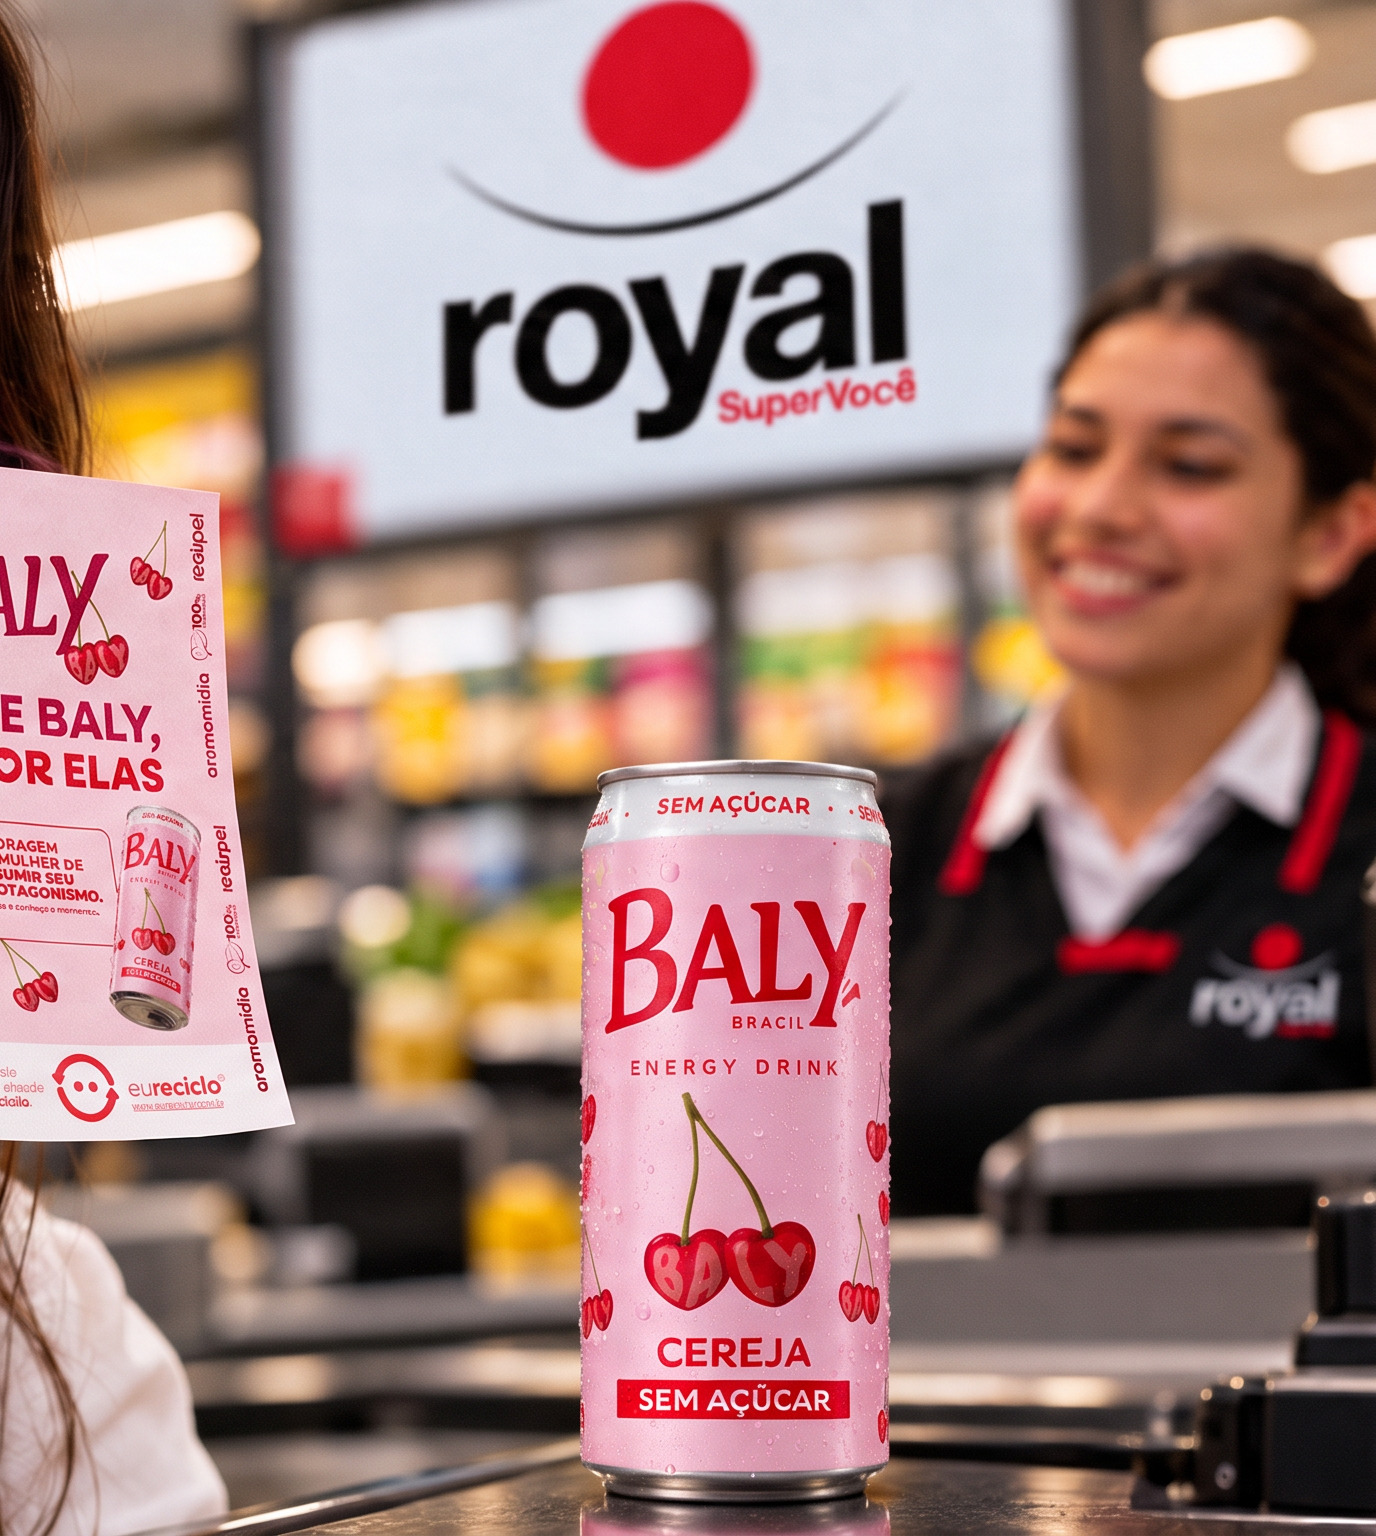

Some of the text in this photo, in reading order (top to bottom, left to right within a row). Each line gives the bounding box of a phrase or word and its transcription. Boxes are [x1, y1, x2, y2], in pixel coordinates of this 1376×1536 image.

[442, 198, 908, 441] royal
[37, 697, 162, 754] BALY,
[63, 747, 165, 793] ELAS
[656, 791, 810, 818] SEM AÇÚCAR
[63, 858, 84, 872] DE
[124, 832, 197, 885] BALY
[45, 872, 75, 886] SEU
[604, 887, 867, 1034] BALY
[731, 1015, 804, 1030] BRACIL
[630, 1059, 839, 1076] ENERGY DRINK
[128, 1075, 222, 1097] eureciclo
[652, 1239, 807, 1309] BALY
[656, 1337, 812, 1368] CEREJA
[638, 1388, 699, 1412] SEM
